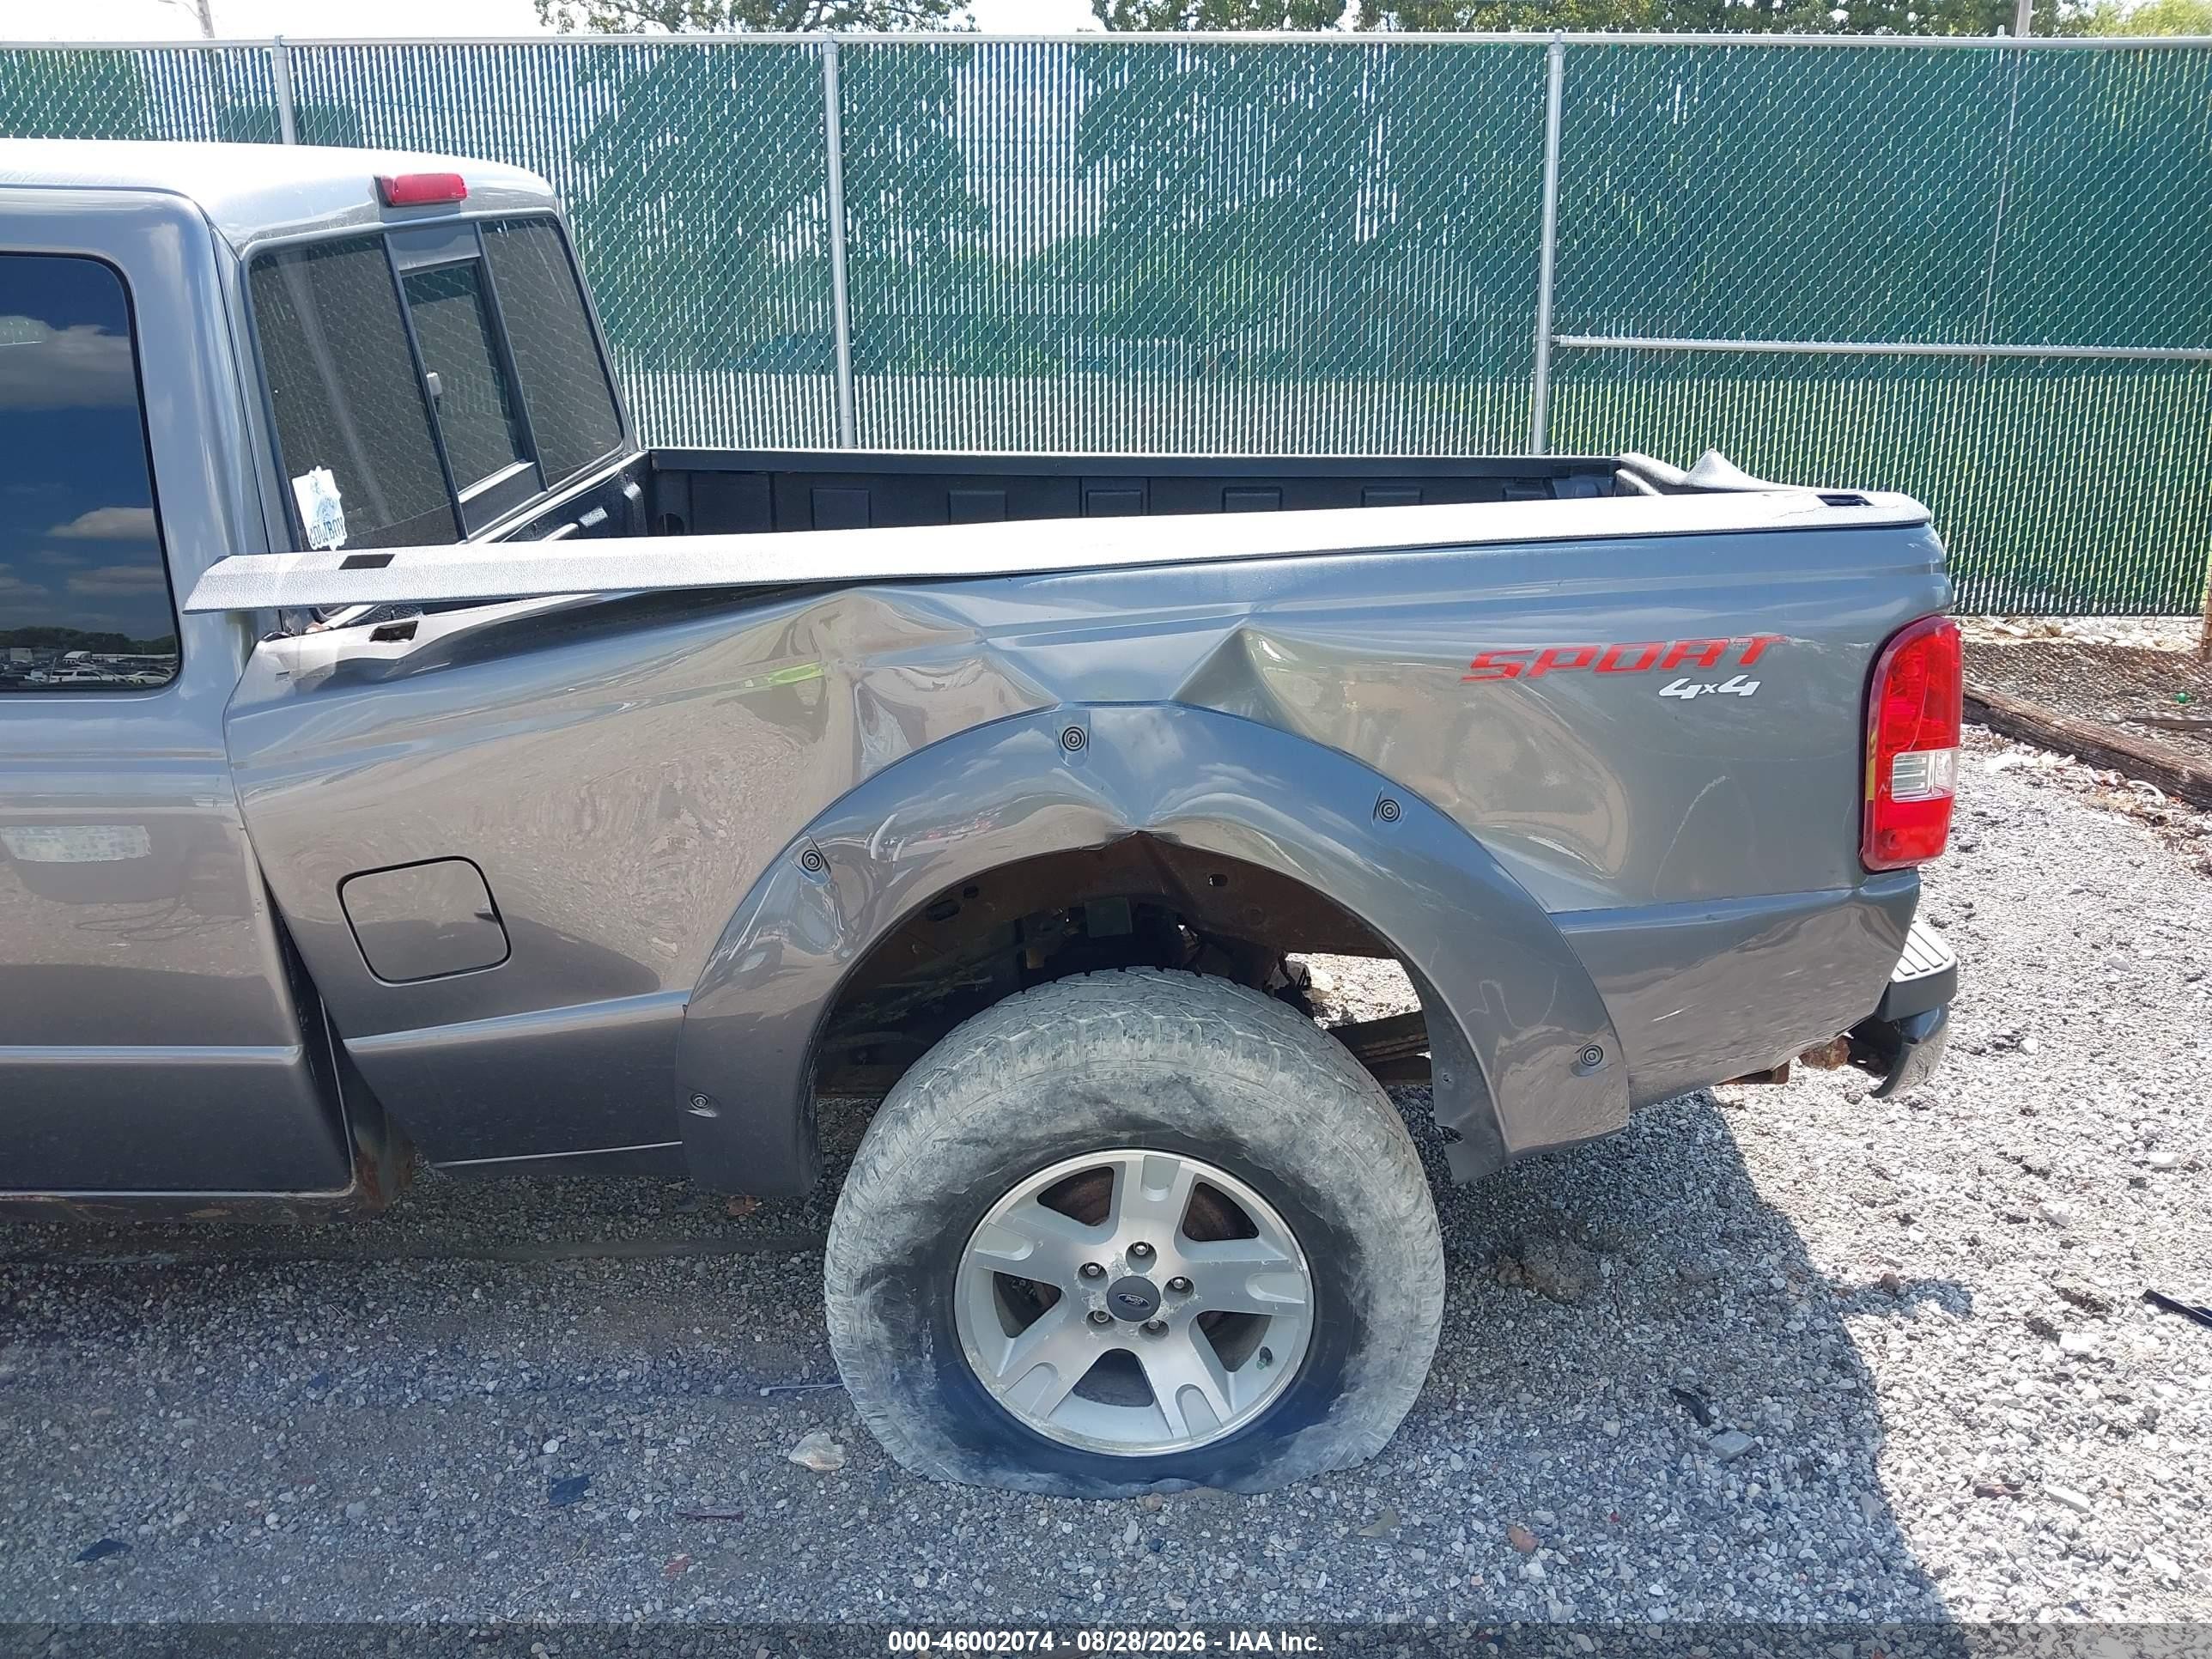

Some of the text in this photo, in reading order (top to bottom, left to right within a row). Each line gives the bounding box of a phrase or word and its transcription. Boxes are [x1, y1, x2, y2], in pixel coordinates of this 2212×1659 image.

[309, 516, 346, 547] COWBOY
[1461, 634, 1788, 683] SPORT
[1658, 674, 1761, 700] 4x4
